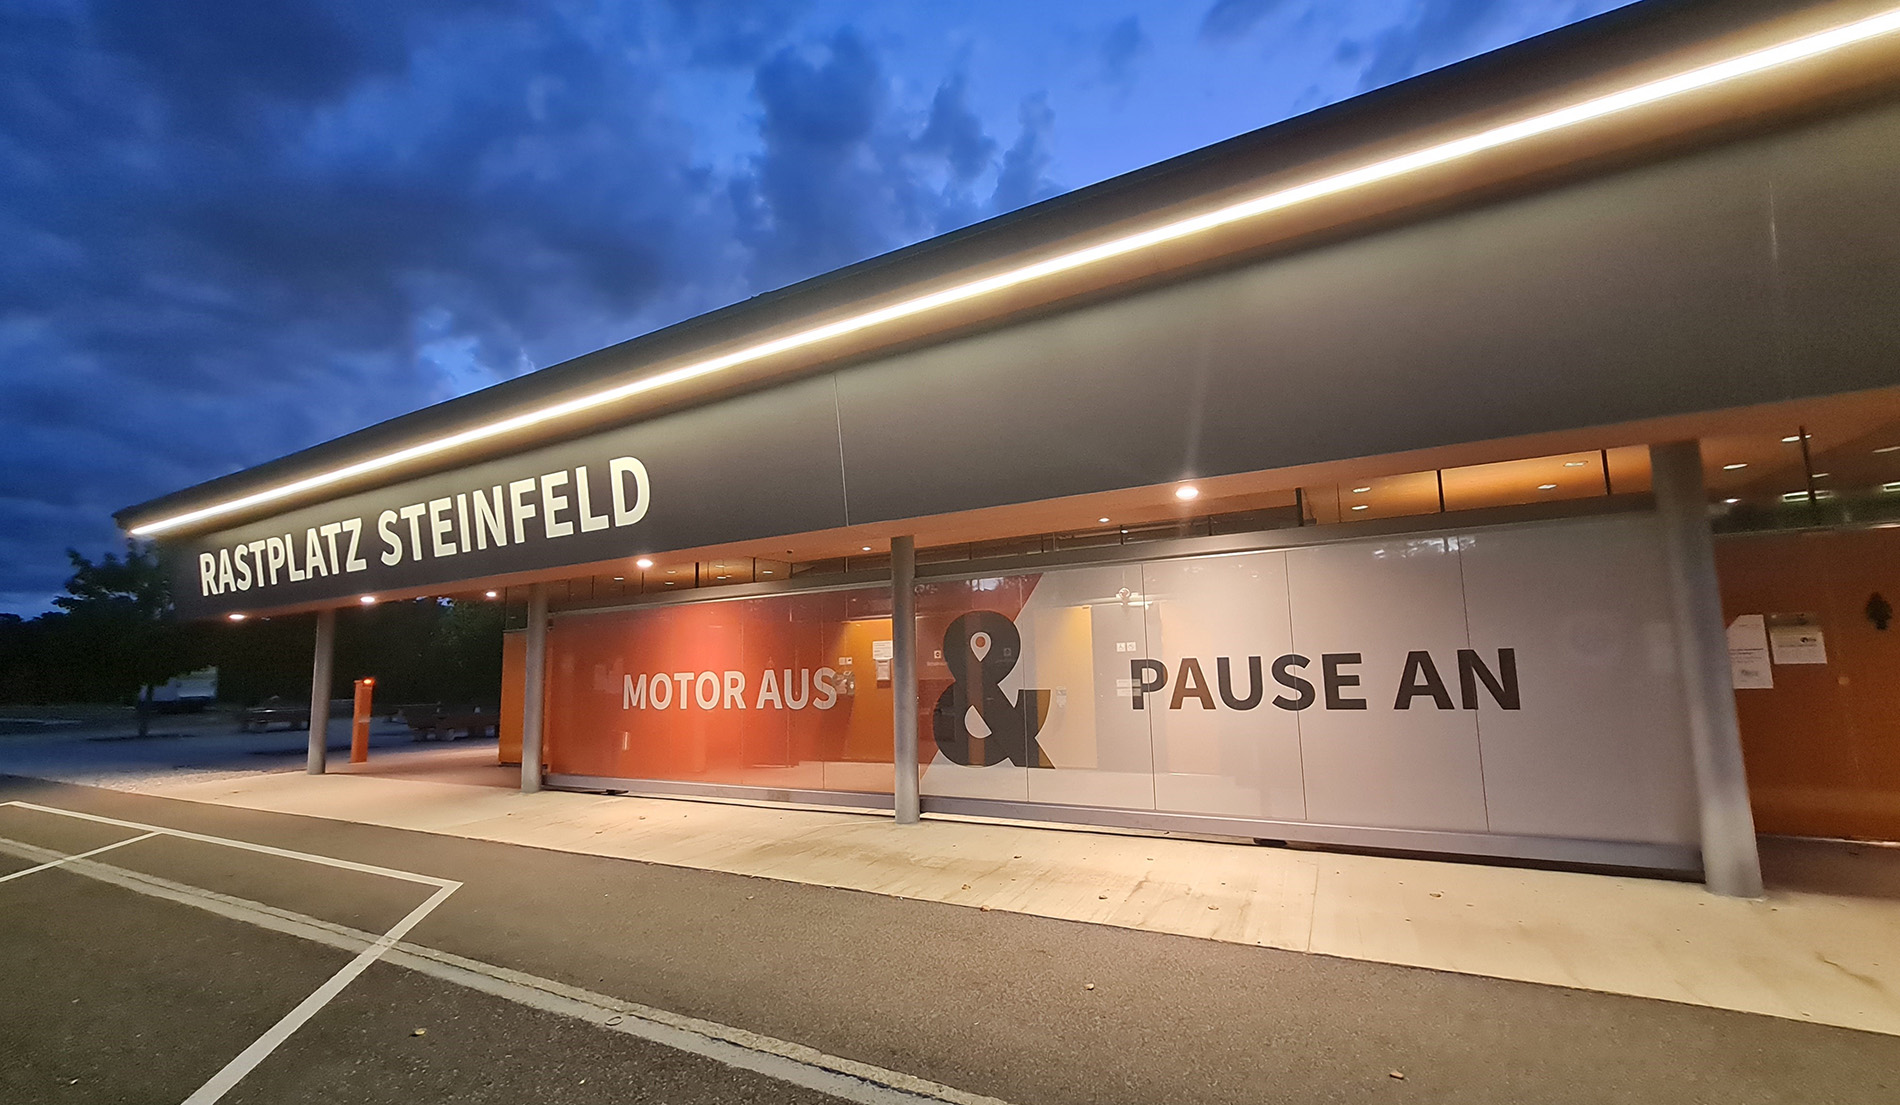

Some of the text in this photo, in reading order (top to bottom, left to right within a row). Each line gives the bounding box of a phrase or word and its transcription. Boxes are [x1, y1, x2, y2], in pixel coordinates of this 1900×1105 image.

[200, 456, 652, 597] RASTPLATZ STEINFELD
[623, 610, 1521, 768] MOTOR AUS & PAUSE AN
